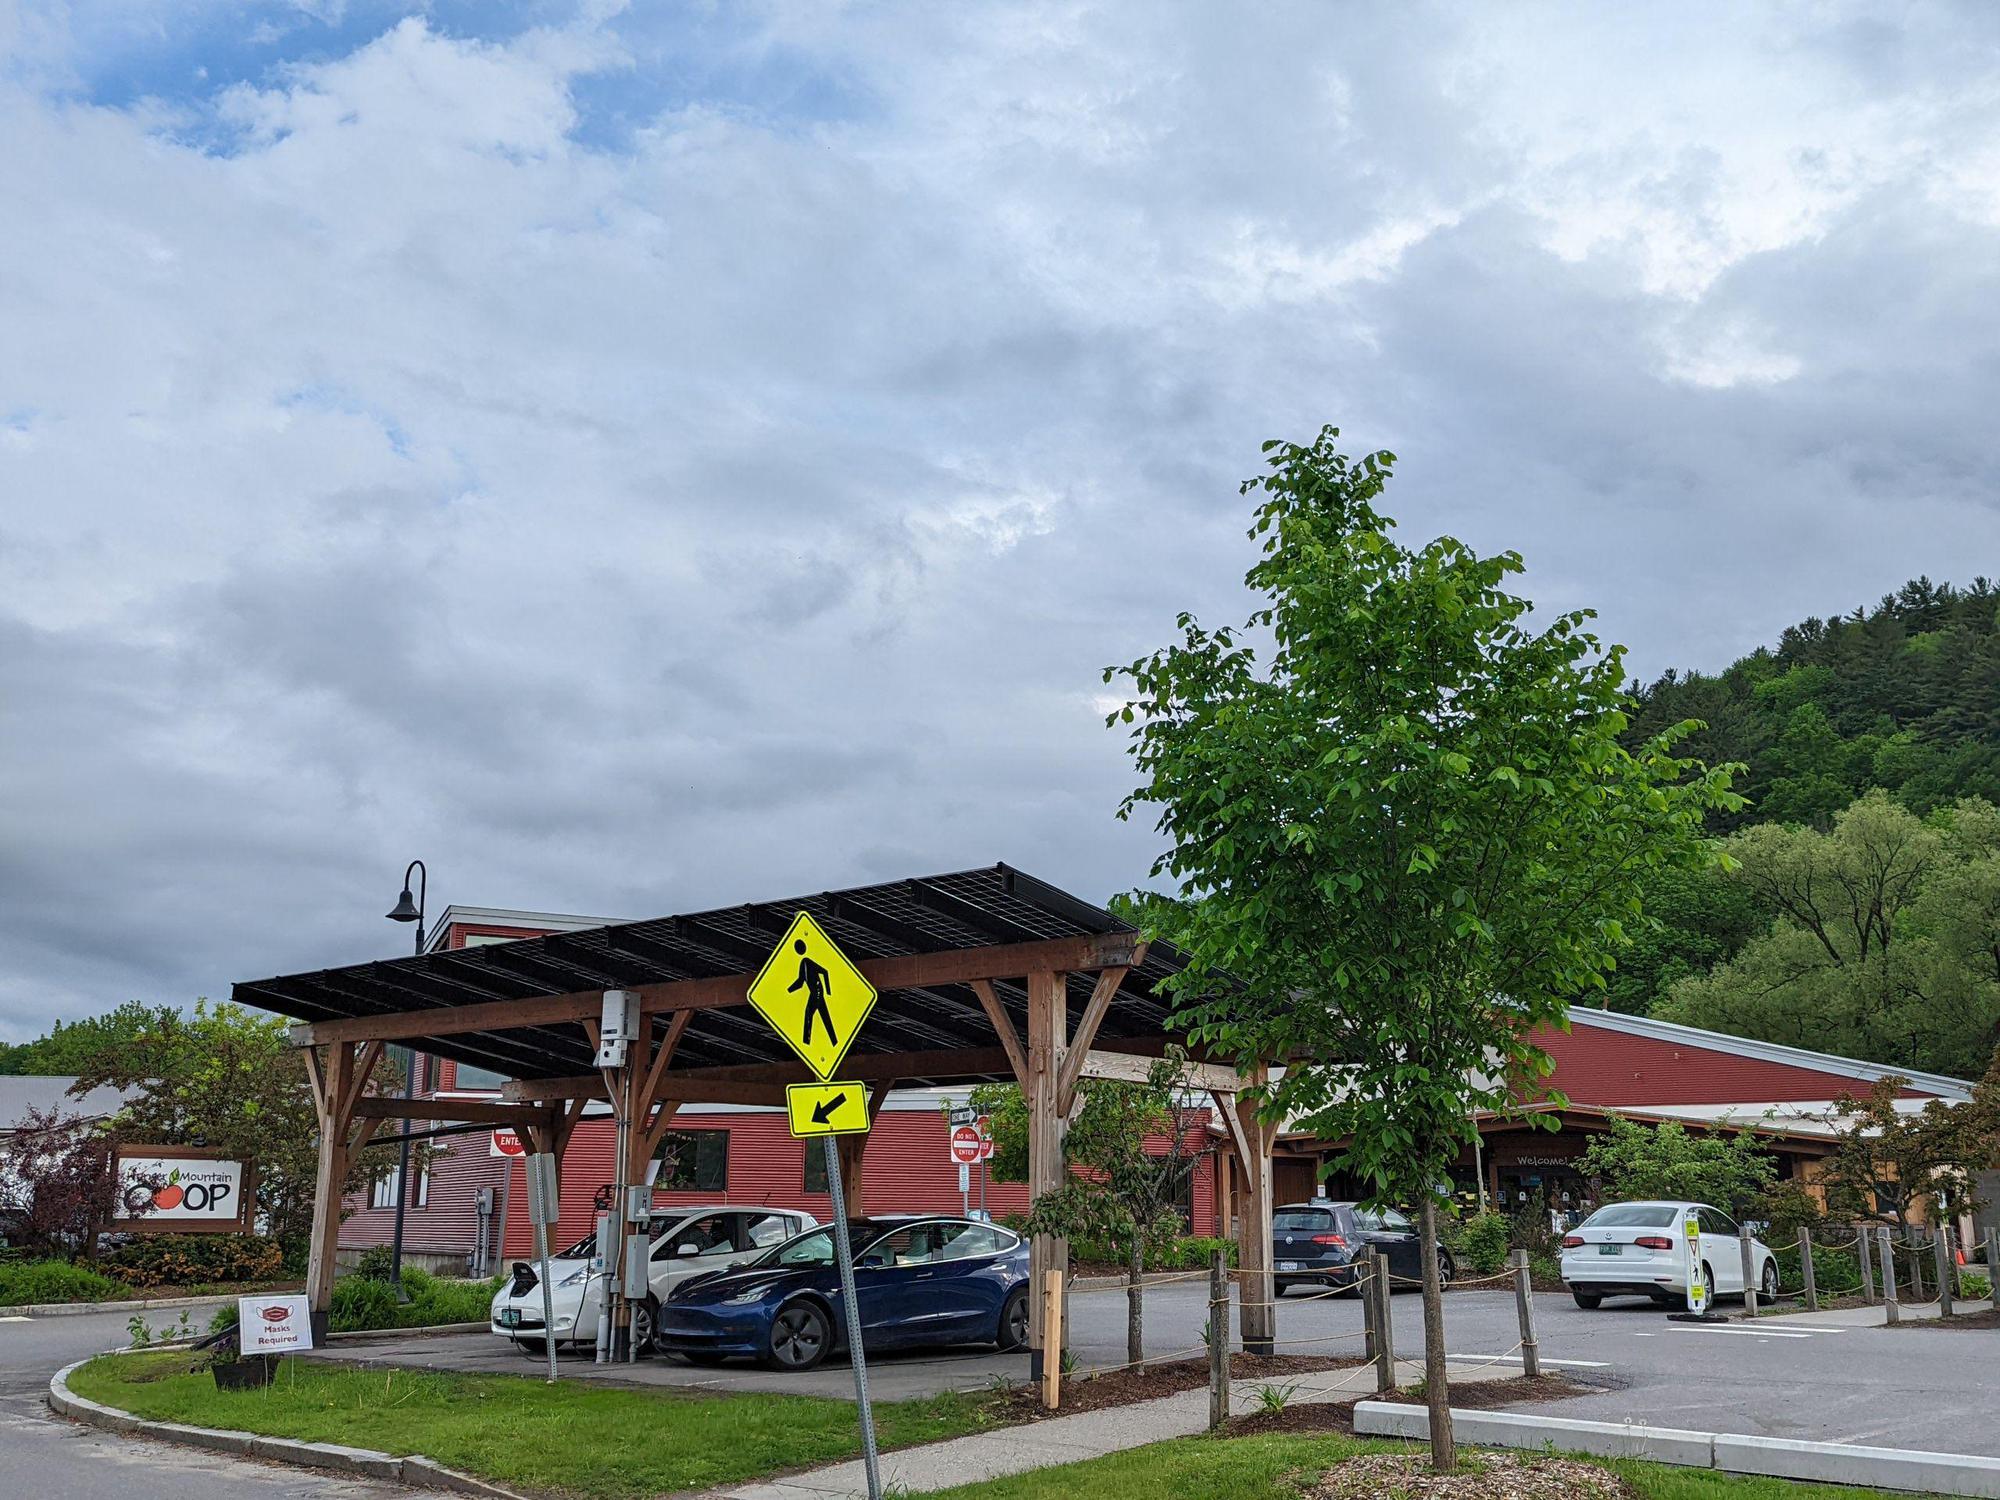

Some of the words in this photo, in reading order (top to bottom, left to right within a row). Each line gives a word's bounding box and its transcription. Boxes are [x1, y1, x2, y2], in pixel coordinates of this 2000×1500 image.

[500, 1136, 521, 1145] ENTE
[1516, 1155, 1568, 1166] Welcome!
[179, 1172, 232, 1182] Mountain
[264, 1324, 291, 1333] Masks
[257, 1335, 298, 1345] Required
